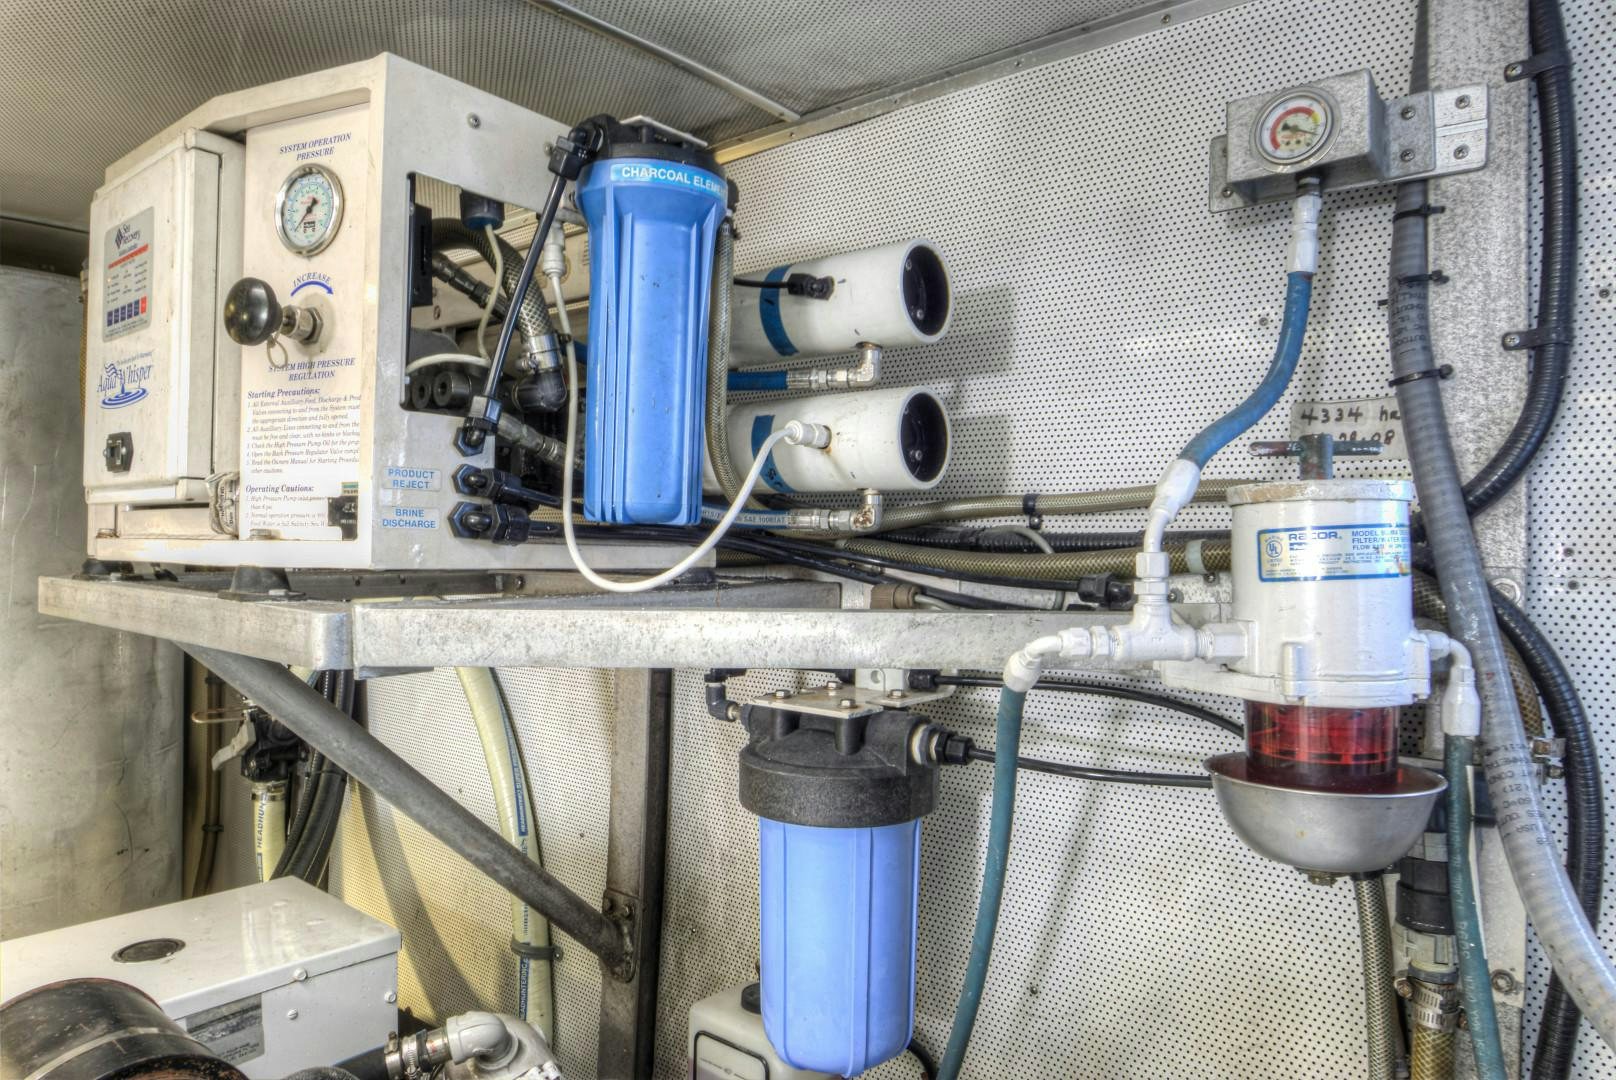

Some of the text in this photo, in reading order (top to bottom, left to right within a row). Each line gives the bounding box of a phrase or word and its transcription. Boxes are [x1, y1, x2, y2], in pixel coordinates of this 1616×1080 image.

[280, 133, 352, 154] SYSTEM OPERATION
[296, 147, 334, 160] PRESSURE
[622, 166, 691, 184] CHARCOAL
[294, 272, 332, 286] INCREASE
[297, 361, 316, 370] HIGH
[317, 358, 356, 368] PRESSURE
[288, 370, 335, 381] REGULATION
[248, 387, 320, 399] Starting Precautions:
[1301, 406, 1363, 426] 4334
[388, 468, 434, 479] PRODUCT
[246, 484, 279, 494] Operating
[393, 480, 432, 488] REJECT
[396, 508, 424, 518] BRINE
[382, 518, 436, 528] DISCHARGE
[1288, 532, 1338, 541] RAOR
